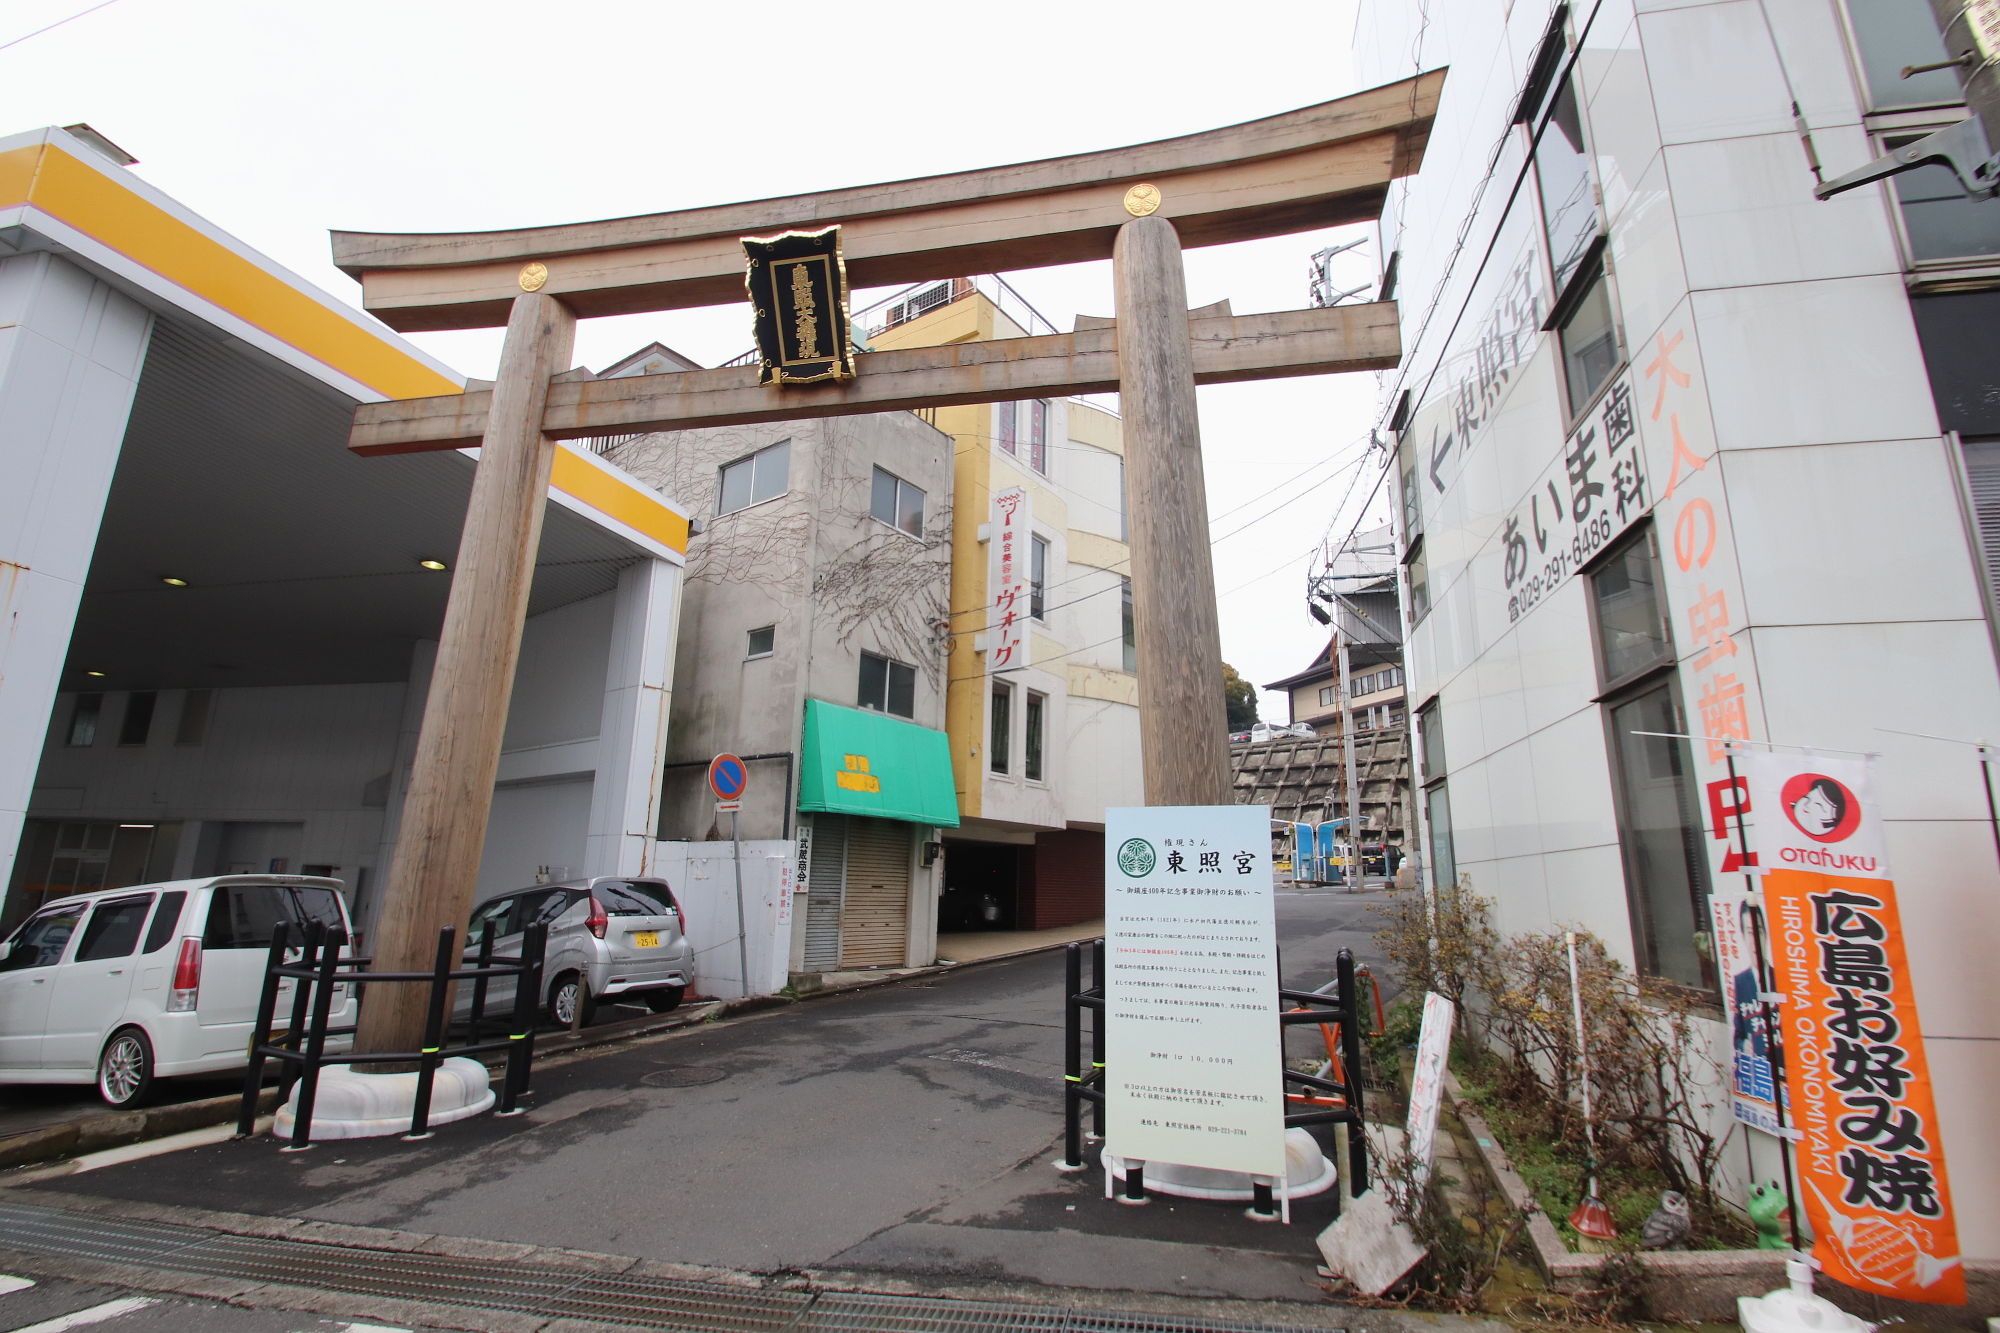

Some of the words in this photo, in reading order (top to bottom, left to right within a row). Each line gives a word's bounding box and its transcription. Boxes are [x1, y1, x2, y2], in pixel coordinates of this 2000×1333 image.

[1452, 250, 1538, 462] 東照宮
[1502, 425, 1605, 591] あいま
[1602, 380, 1646, 525] 歯科
[1519, 509, 1612, 615] 029-291-6486
[1645, 329, 1751, 766] 大人の虫歯
[994, 585, 1022, 668] ヴォーグ
[1164, 838, 1208, 847] 権現さん
[1165, 850, 1257, 875] 東照宮
[1707, 776, 1752, 839] P
[1779, 896, 1812, 1011] HIROSHIMA
[1796, 1016, 1834, 1176] OKONOMIYAKI
[1810, 889, 1942, 1218] 広島お好み焼
